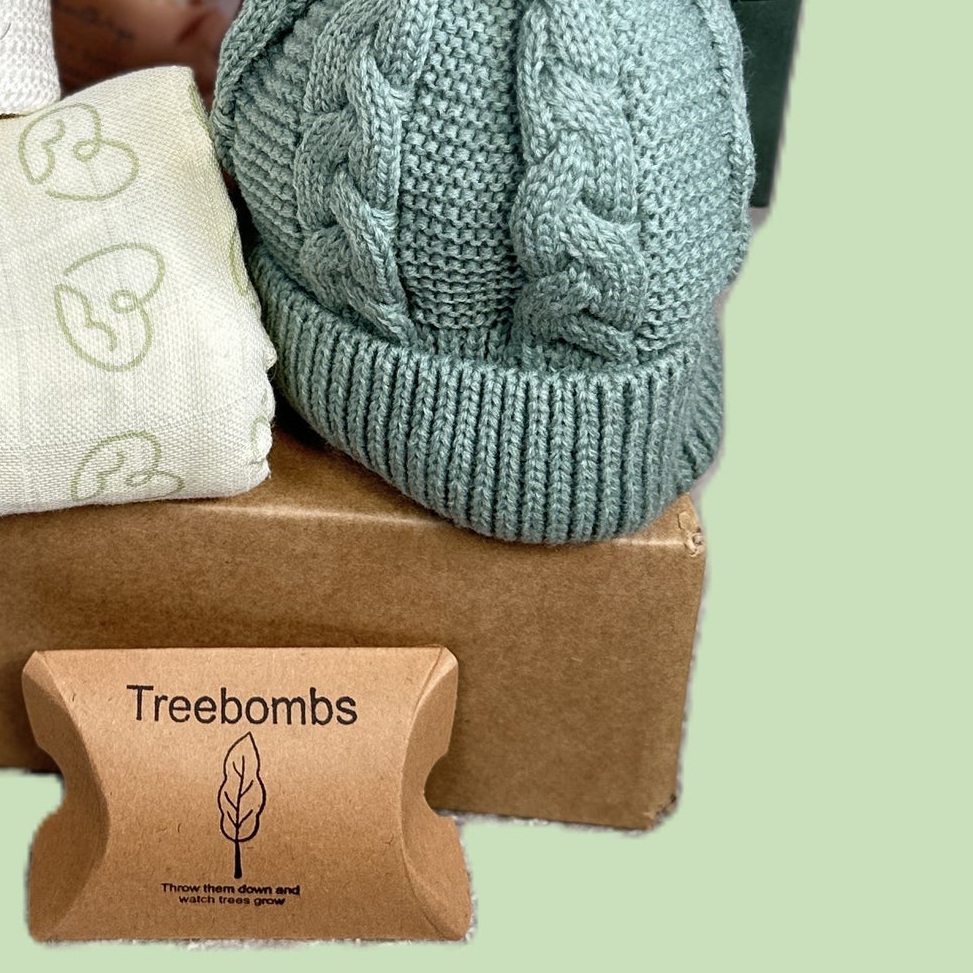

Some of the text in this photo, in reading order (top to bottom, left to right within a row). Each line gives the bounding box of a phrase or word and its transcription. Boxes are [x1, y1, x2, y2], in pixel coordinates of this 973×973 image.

[127, 684, 358, 726] Treebombs
[161, 882, 301, 896] Throw them down and
[178, 894, 286, 907] watch trees grow
